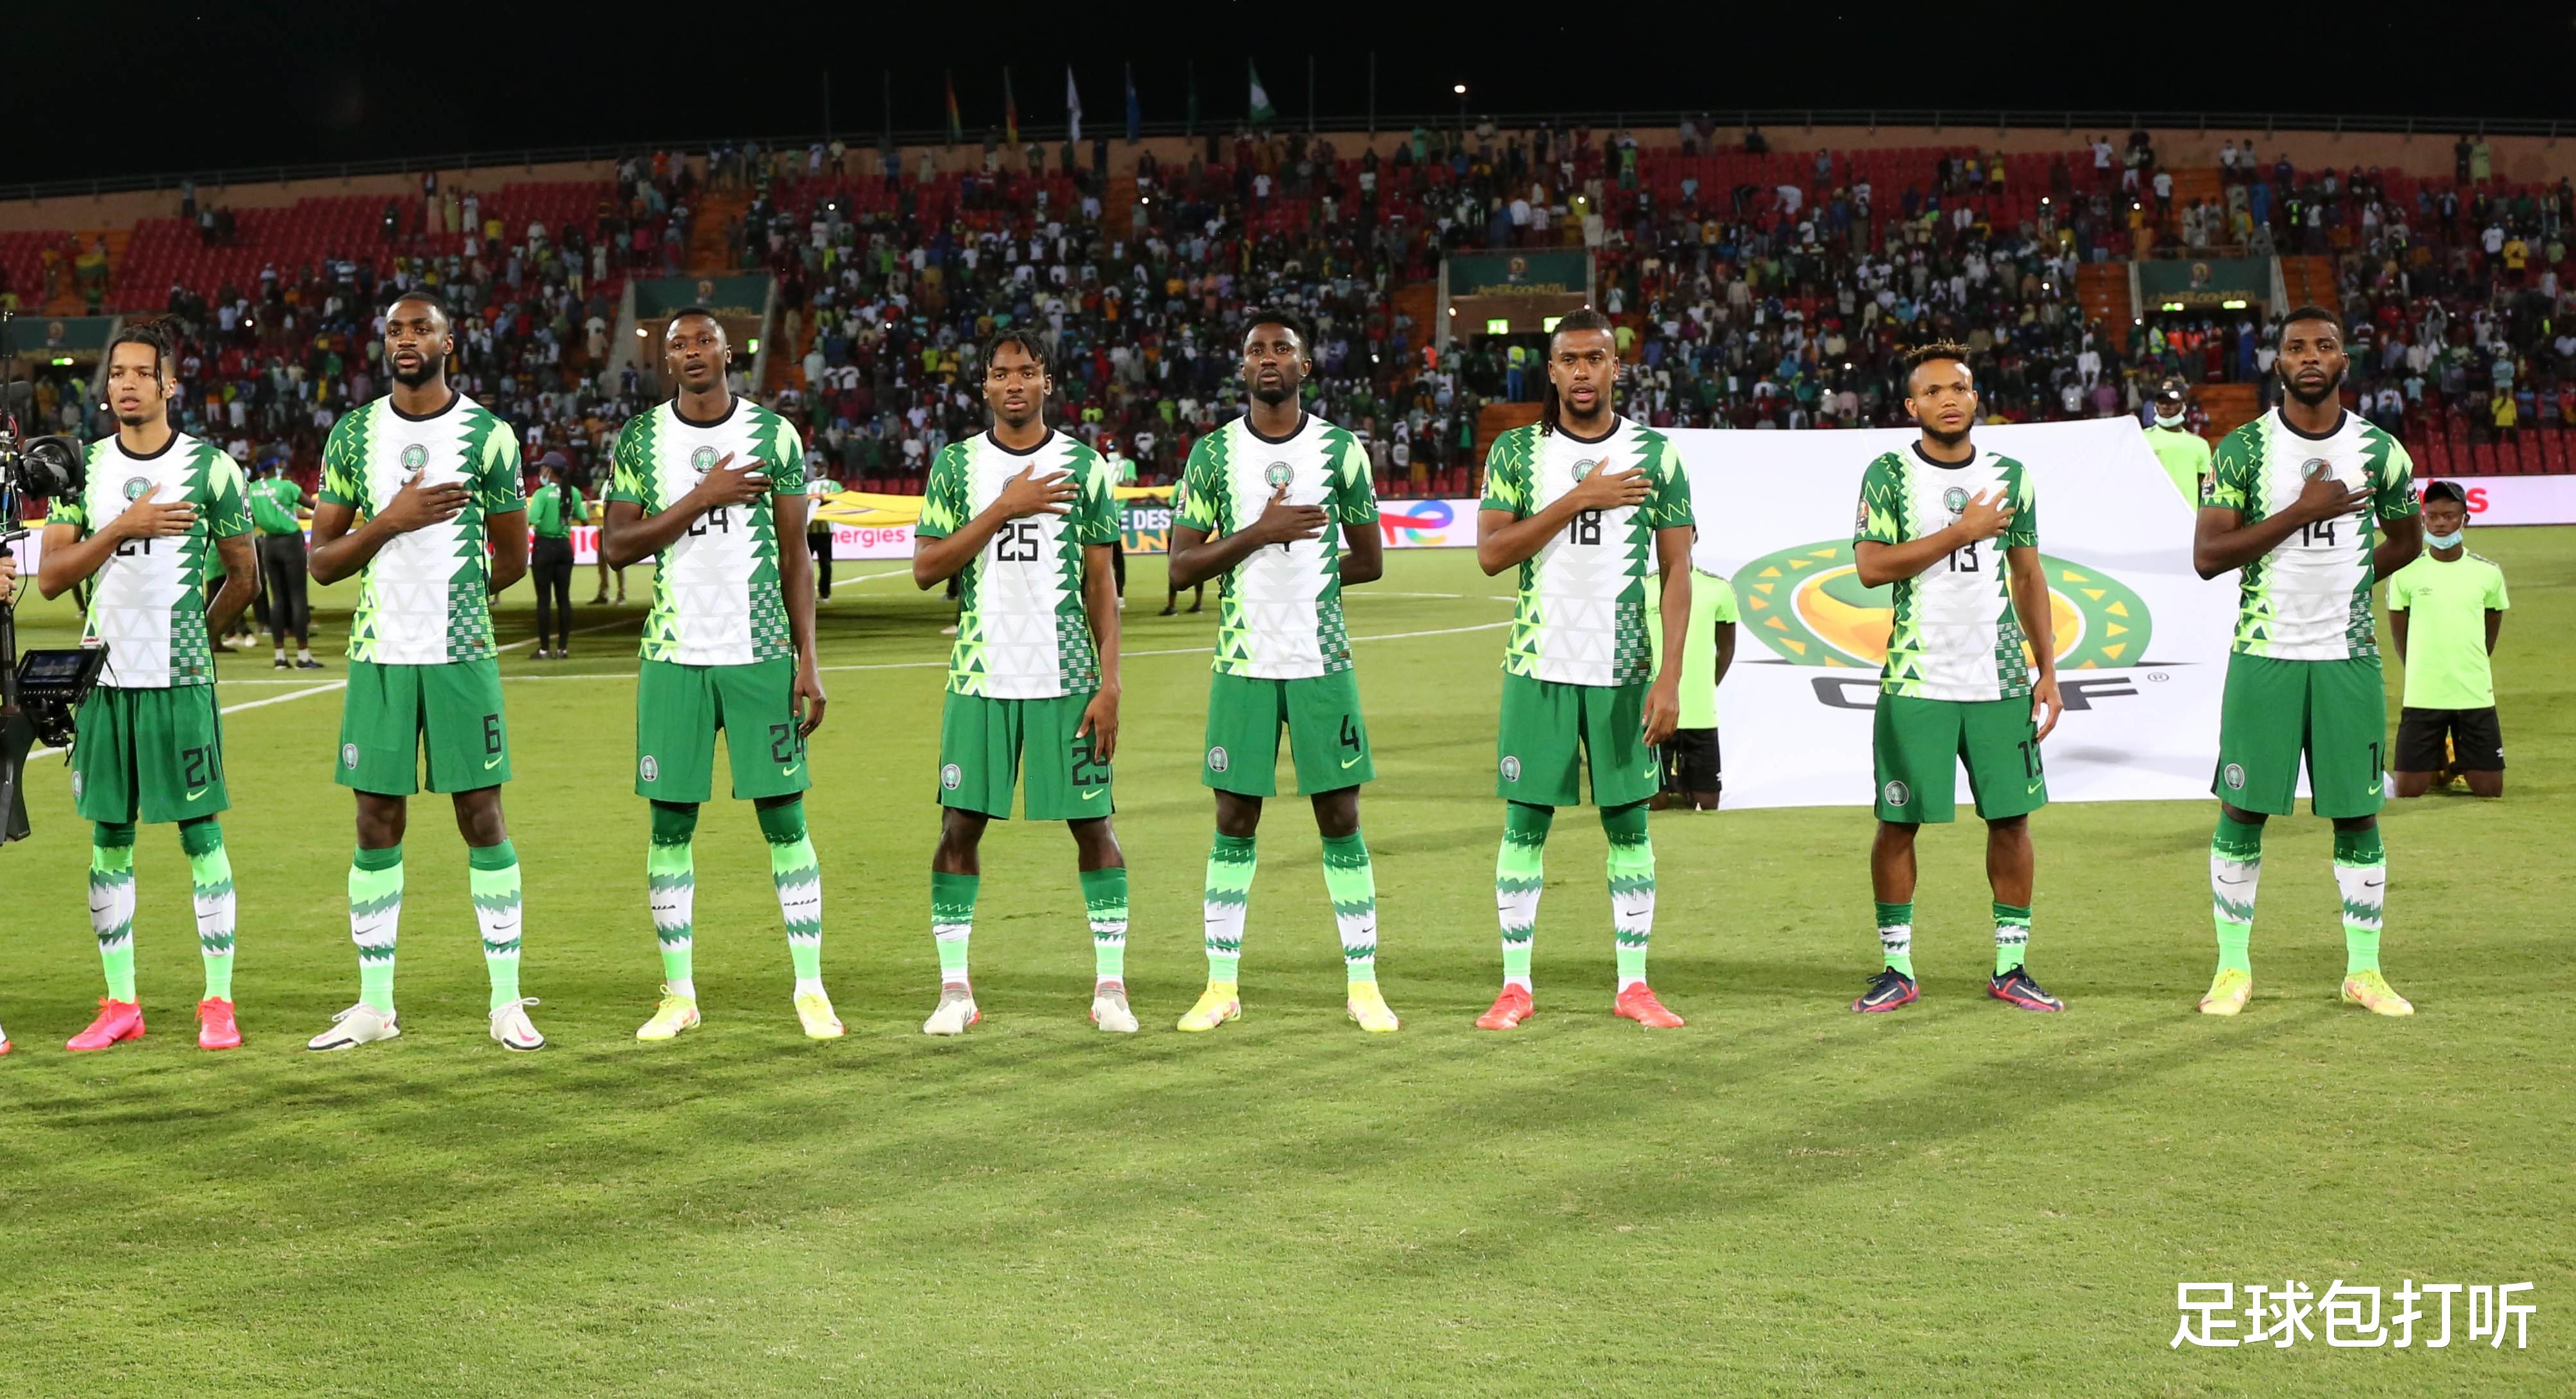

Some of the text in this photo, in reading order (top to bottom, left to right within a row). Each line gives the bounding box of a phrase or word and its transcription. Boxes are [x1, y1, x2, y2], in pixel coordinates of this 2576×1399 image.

[1133, 508, 1171, 530] DES
[1570, 510, 1601, 545] 18
[2304, 521, 2335, 547] 14
[998, 523, 1038, 561] 25
[1950, 540, 1979, 572] 13
[483, 714, 502, 754] 6
[1340, 714, 1360, 752] 4
[182, 744, 217, 788] 21
